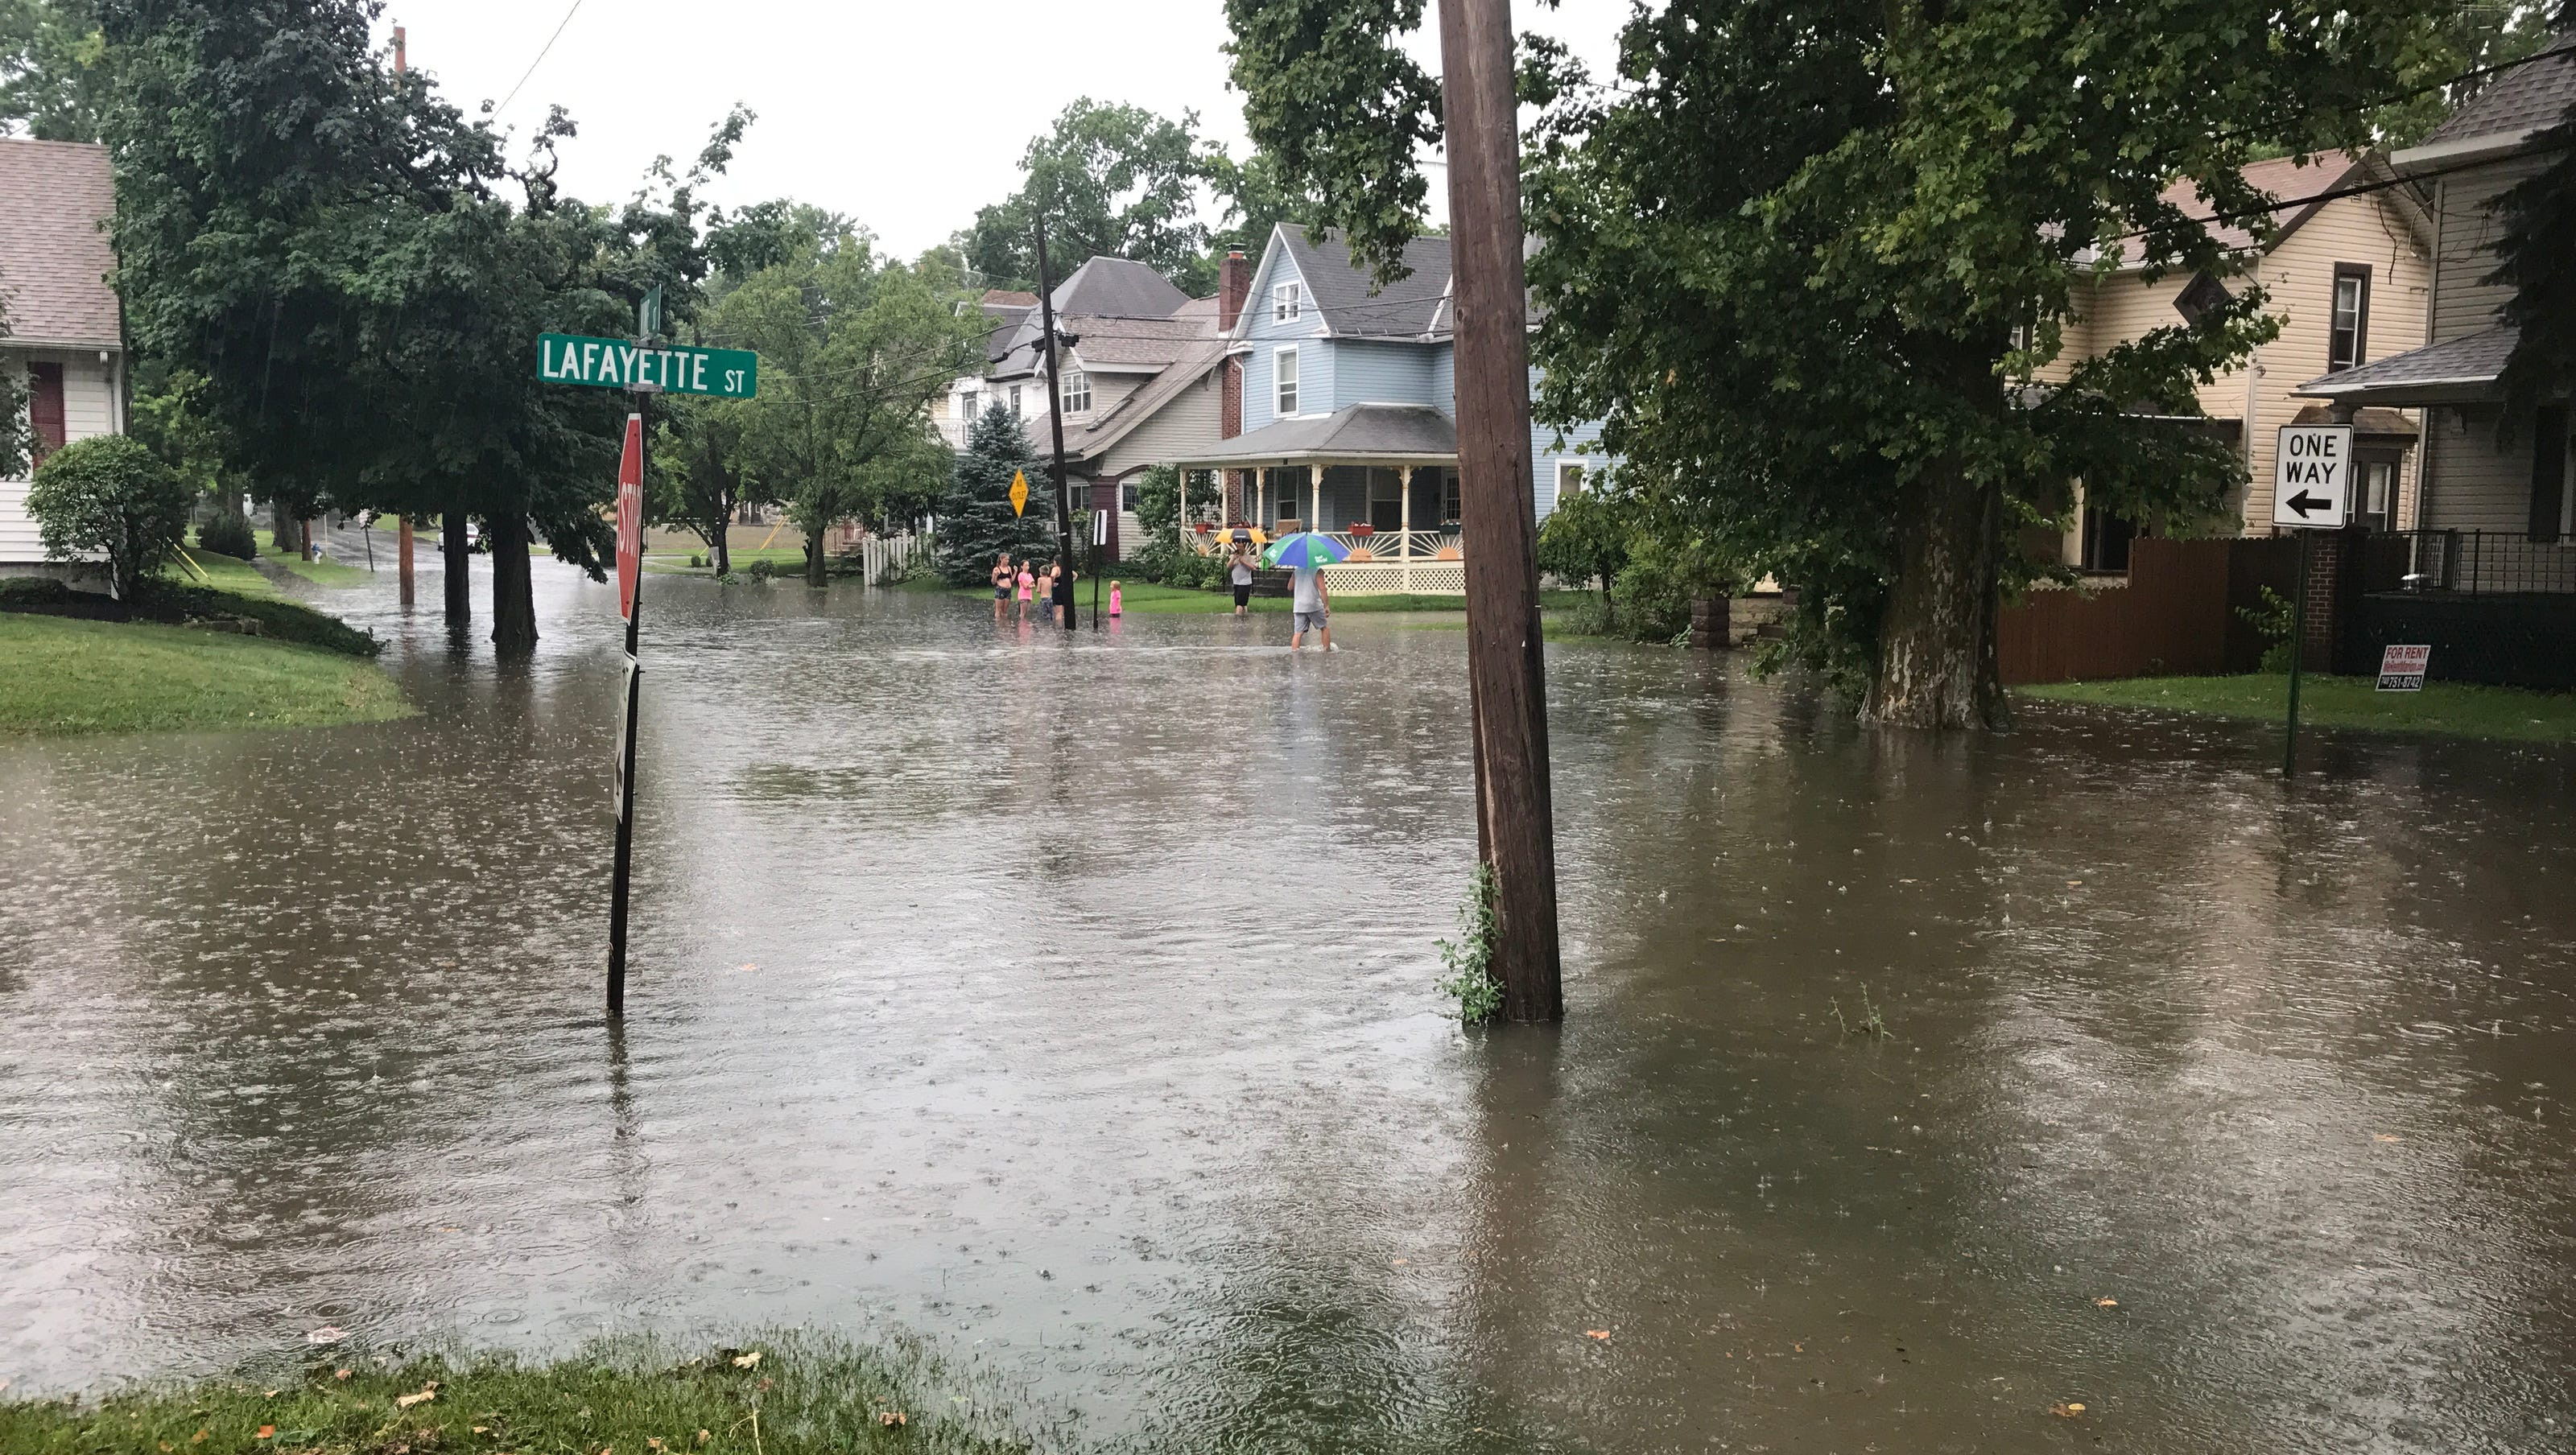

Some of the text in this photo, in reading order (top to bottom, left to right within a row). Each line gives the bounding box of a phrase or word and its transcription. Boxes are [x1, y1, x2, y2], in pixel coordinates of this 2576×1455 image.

[543, 340, 745, 394] LAFAYETTE ST
[2289, 434, 2338, 457] ONE
[2286, 461, 2337, 484] WAY
[619, 481, 641, 559] STOP
[2385, 647, 2429, 659] FOR RENT
